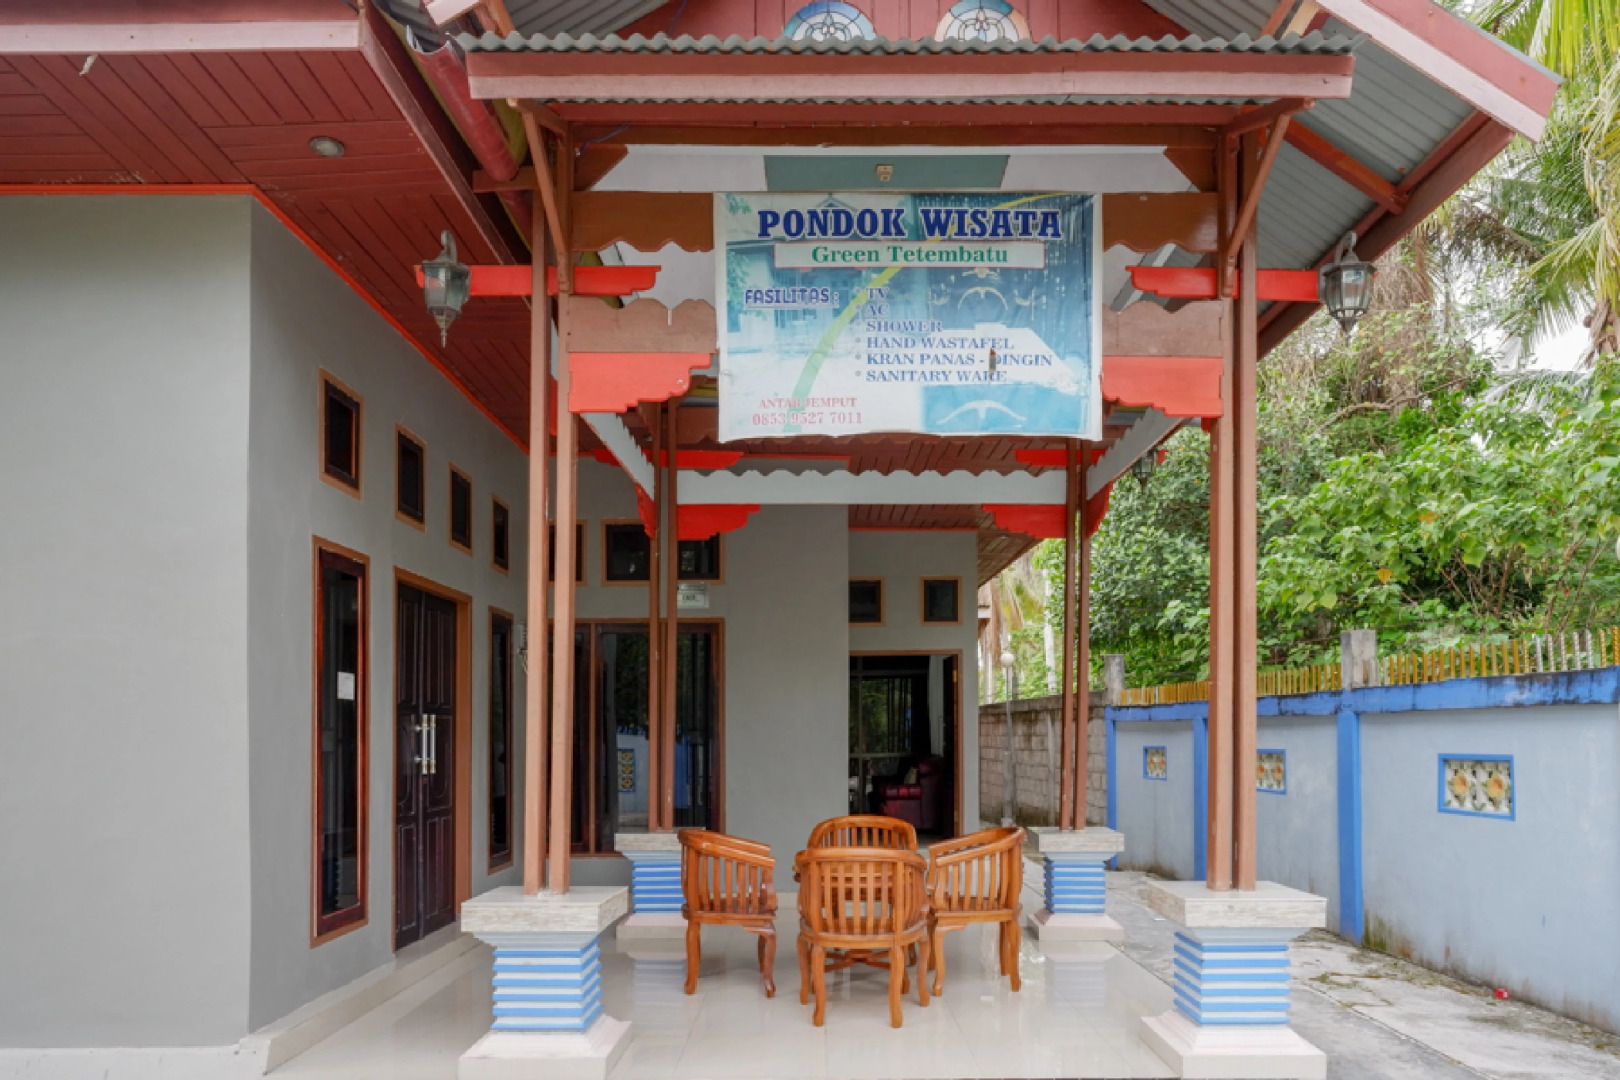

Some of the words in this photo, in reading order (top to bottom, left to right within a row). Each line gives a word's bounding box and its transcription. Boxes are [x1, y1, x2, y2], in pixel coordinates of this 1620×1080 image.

[757, 208, 907, 238] PONDOK
[919, 208, 1062, 239] WISATA
[811, 246, 880, 263] Green
[887, 245, 1008, 263] Tetembatu
[866, 287, 888, 299] TV
[866, 321, 943, 332] SHOWER
[866, 336, 916, 349] HAND
[920, 337, 1014, 349] WASTAFEL
[867, 353, 915, 365] KRAN
[919, 354, 975, 365] PANAS
[866, 370, 952, 381] SANITARY
[805, 397, 857, 408] JEMPUT
[752, 413, 786, 425] 0853
[791, 412, 824, 424] 9527
[829, 412, 863, 424] 7011
